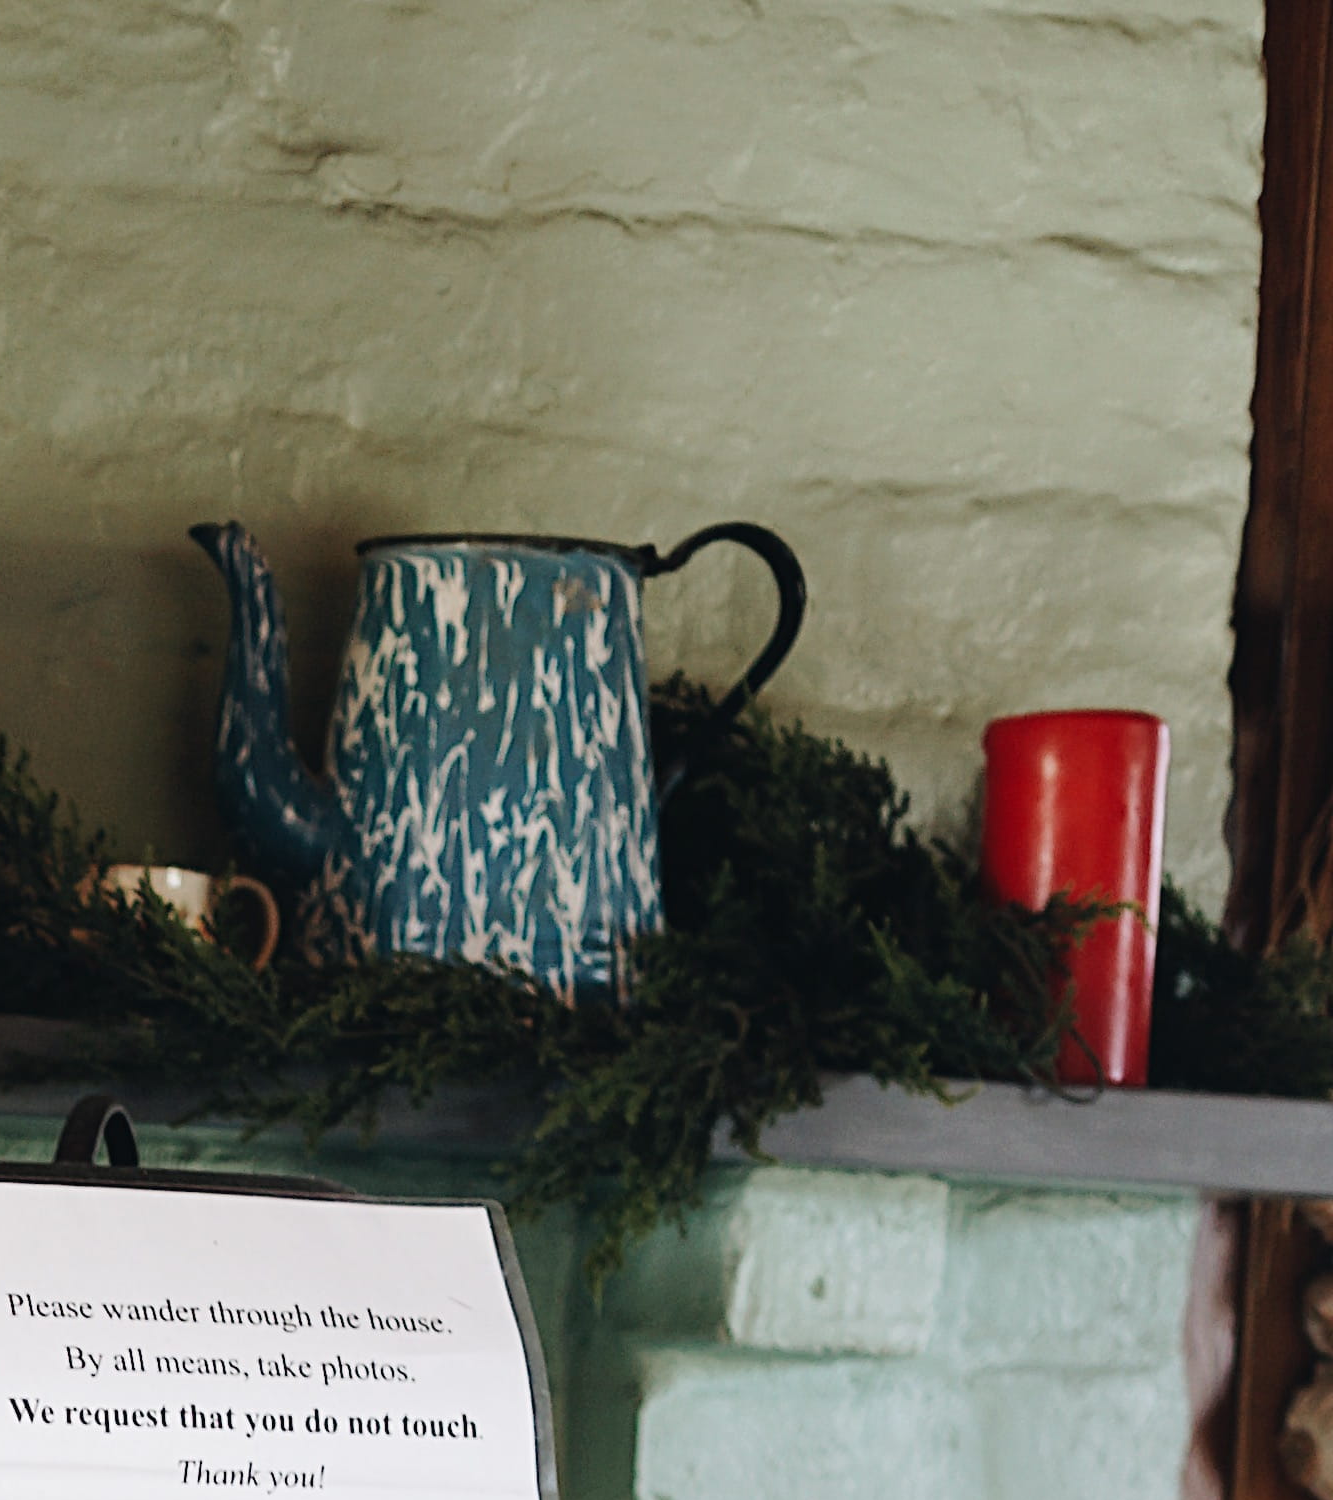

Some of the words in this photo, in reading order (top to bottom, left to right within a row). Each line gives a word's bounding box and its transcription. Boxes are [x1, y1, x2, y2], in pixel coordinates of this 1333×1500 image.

[7, 1293, 93, 1319] Please
[102, 1299, 200, 1322] wander
[209, 1300, 312, 1333] through
[320, 1305, 360, 1329] the
[367, 1308, 452, 1333] house.
[65, 1346, 103, 1377] By
[113, 1348, 145, 1372] all
[156, 1354, 249, 1380] means,
[258, 1353, 312, 1378] take
[322, 1355, 416, 1386] photos.
[9, 1398, 55, 1424] We
[65, 1404, 170, 1433] request
[180, 1403, 234, 1430] that
[245, 1411, 295, 1438] you
[305, 1408, 338, 1434] do
[349, 1413, 392, 1436] not
[402, 1413, 484, 1439] touch.
[178, 1459, 261, 1488] Thank
[268, 1465, 326, 1495] you!
